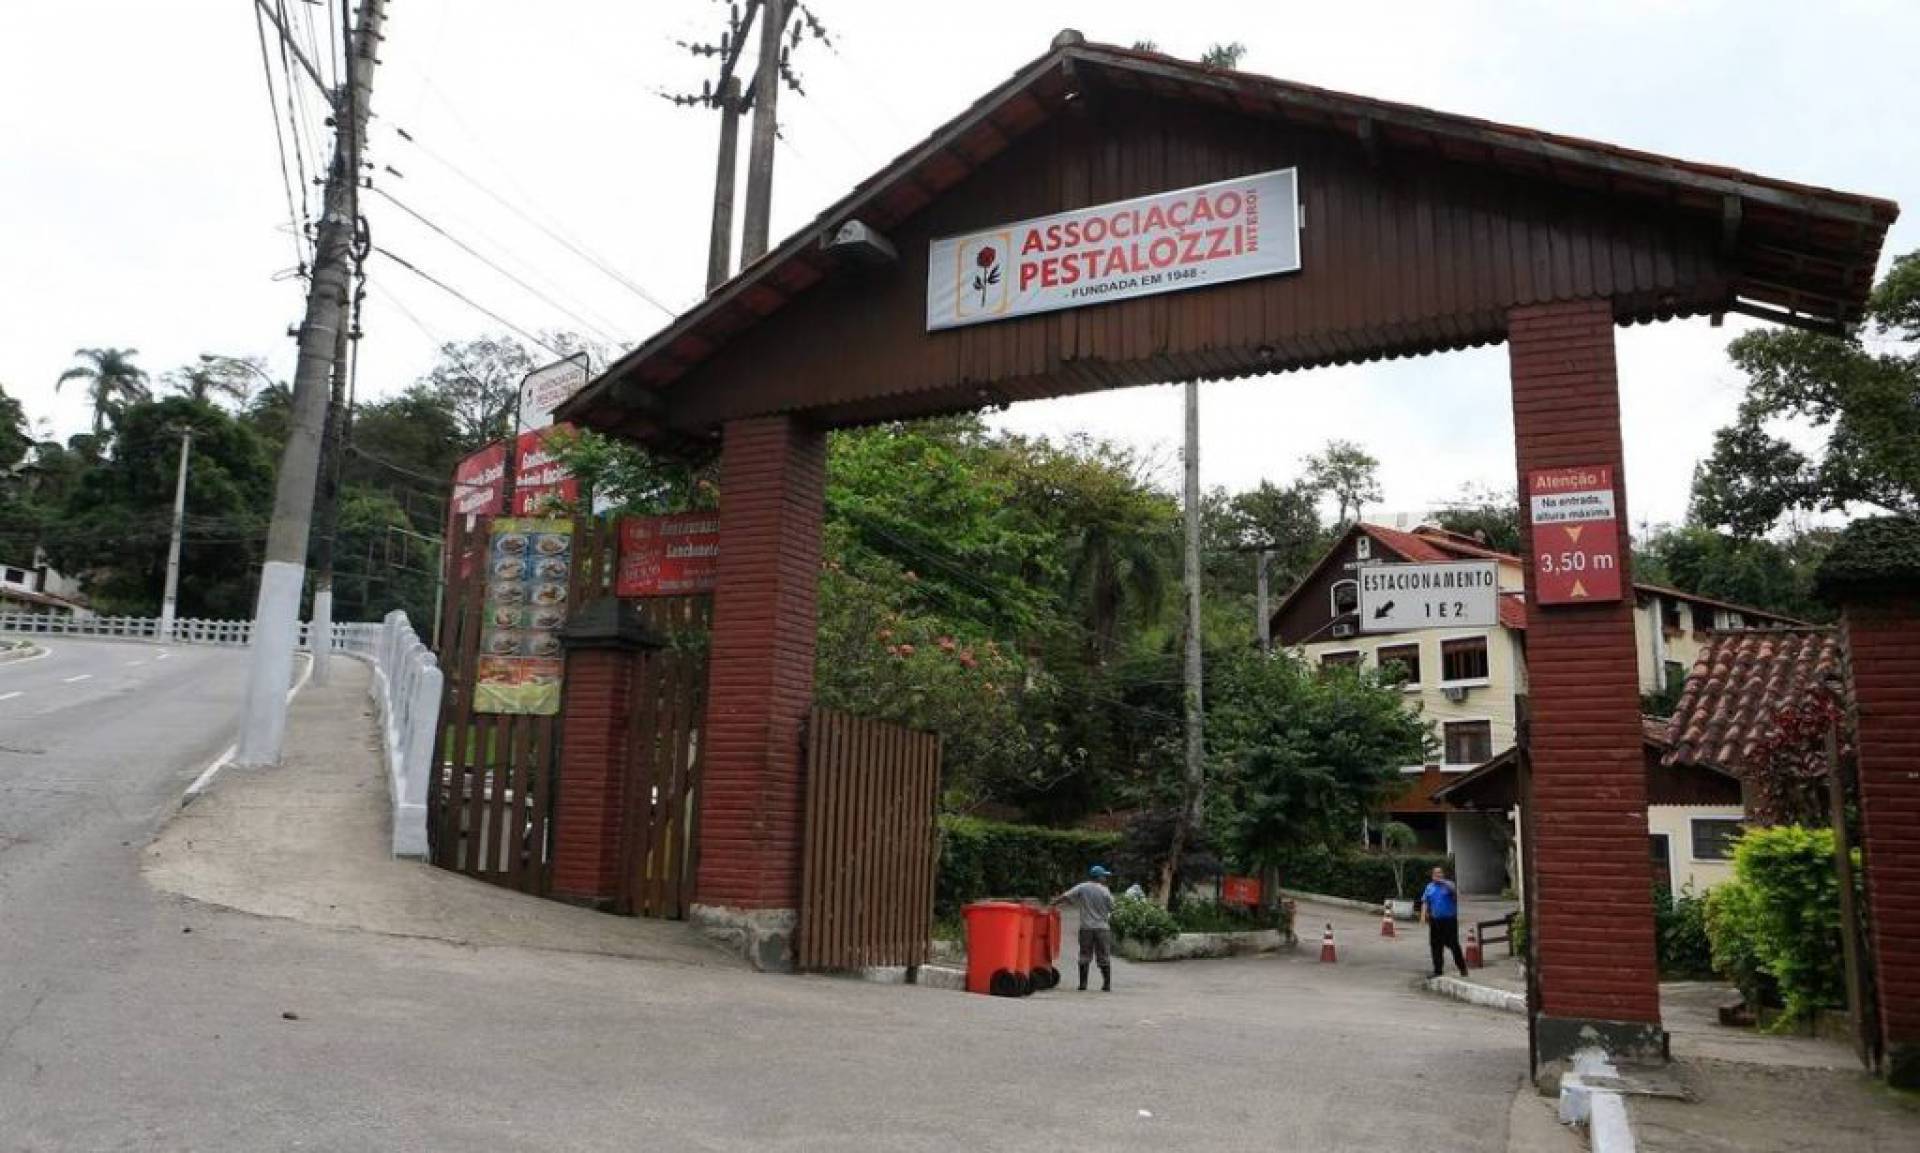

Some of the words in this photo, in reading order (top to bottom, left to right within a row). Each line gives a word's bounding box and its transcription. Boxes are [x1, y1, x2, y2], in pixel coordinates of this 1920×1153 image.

[1021, 189, 1242, 256] ASSOCIAÇÃO
[1019, 224, 1243, 292] PESTALOZZI
[1072, 278, 1137, 298] FUNDADA
[1141, 275, 1163, 286] EM
[1167, 267, 1197, 282] 1948
[1535, 472, 1597, 489] Atenção
[1542, 497, 1557, 507] Na
[1535, 511, 1566, 521] altura
[1568, 509, 1610, 518] máxima
[1541, 551, 1585, 576] 3,50
[1593, 554, 1614, 569] m
[1364, 570, 1493, 592] ESTACIONAMENTO
[1425, 602, 1431, 618] 1
[1439, 602, 1448, 617] E
[1454, 601, 1464, 617] 2
